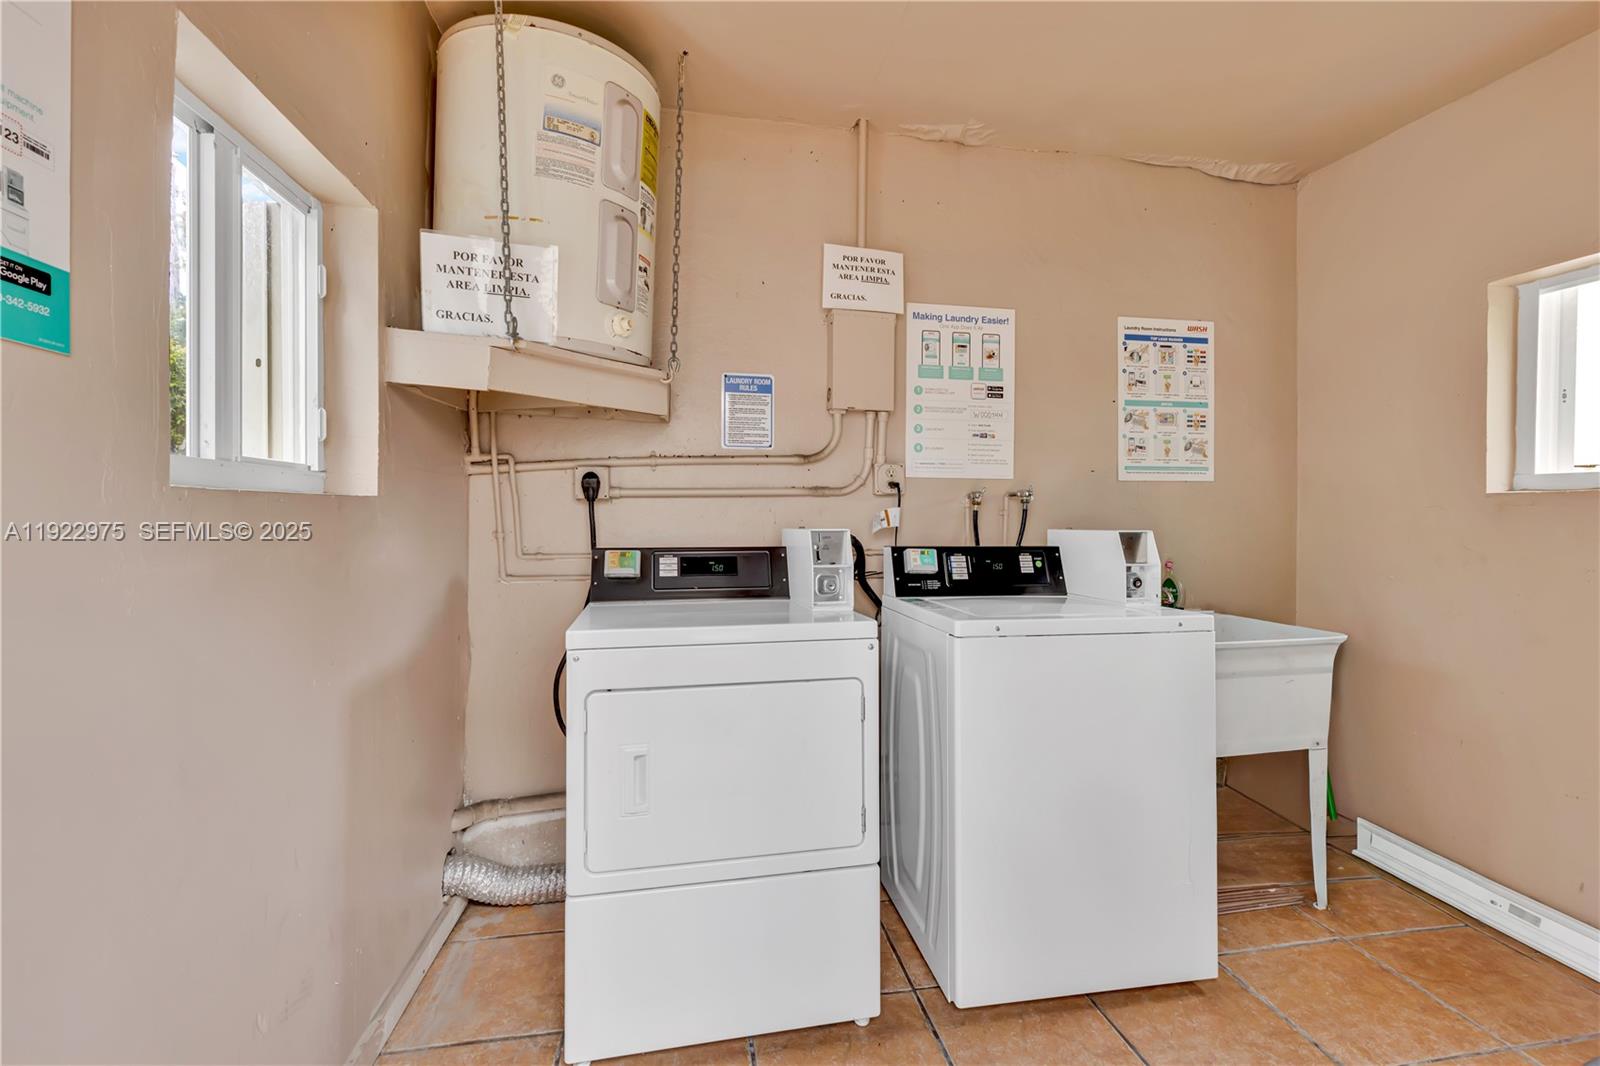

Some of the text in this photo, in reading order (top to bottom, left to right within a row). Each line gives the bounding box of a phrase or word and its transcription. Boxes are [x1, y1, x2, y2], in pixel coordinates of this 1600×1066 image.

[453, 250, 524, 268] POR FAVOR
[843, 255, 886, 265] POR FAVOR
[832, 263, 896, 276] MANTENER ESTA
[0, 266, 47, 291] Google Play
[510, 271, 540, 284] ESTA
[839, 273, 859, 281] AREA
[446, 279, 480, 291] AREA
[435, 309, 494, 324] GRACIAS.
[912, 311, 1009, 325] Making Laundry Easier!
[726, 377, 753, 385] LAUNDRY
[738, 384, 758, 392] RULES
